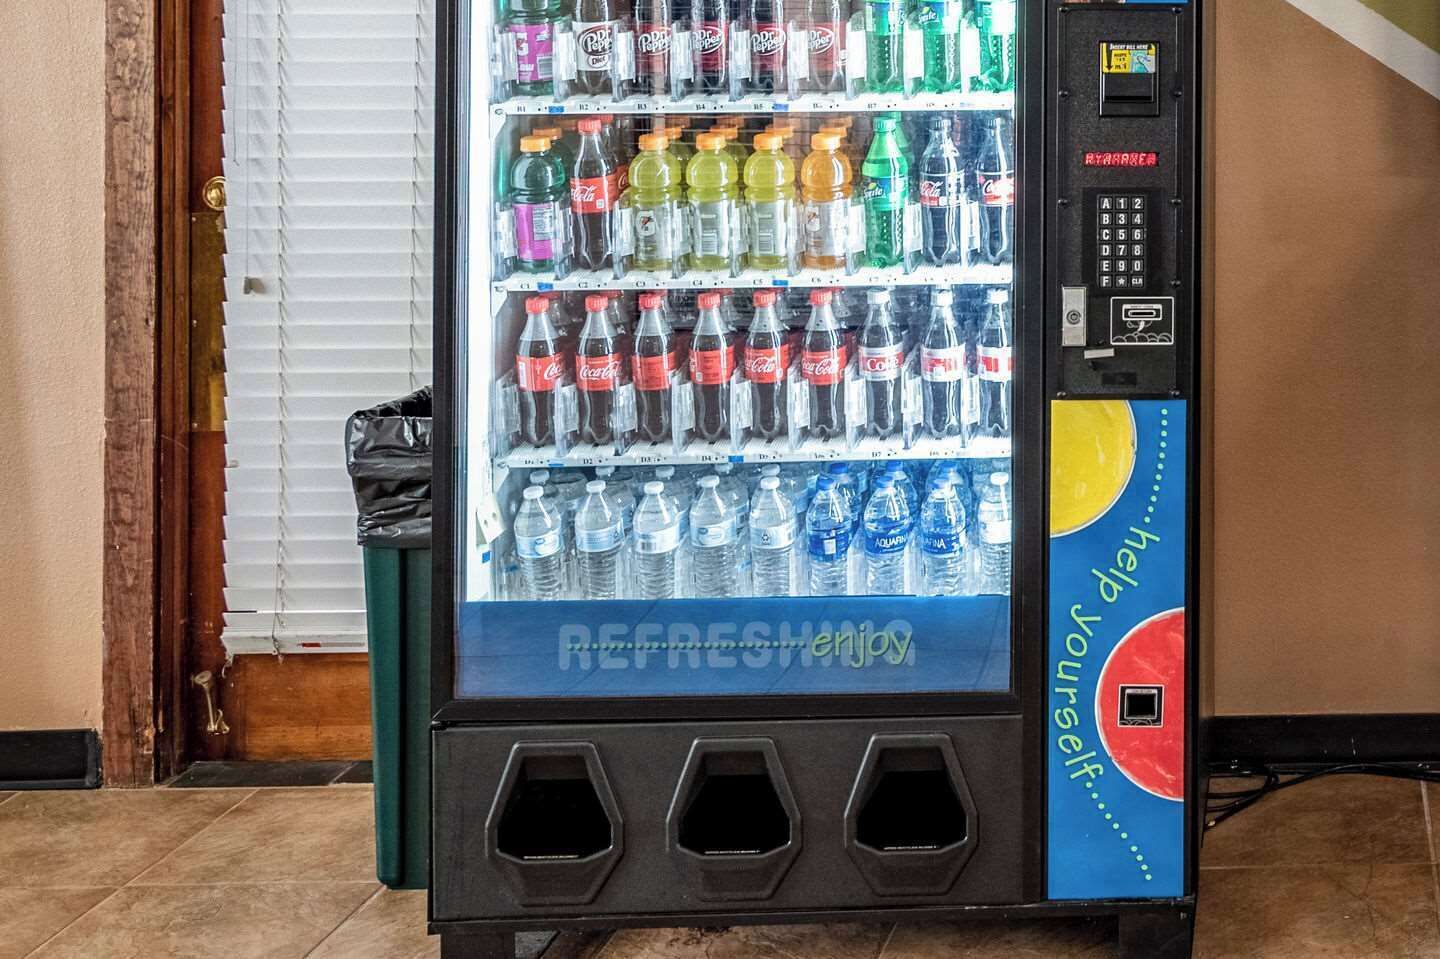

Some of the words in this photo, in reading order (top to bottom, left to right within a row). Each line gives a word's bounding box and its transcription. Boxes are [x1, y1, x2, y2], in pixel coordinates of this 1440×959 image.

[598, 30, 611, 41] Dr
[700, 30, 712, 40] Dr
[760, 30, 775, 41] Dr
[1102, 198, 1110, 209] A
[1119, 198, 1125, 209] 1
[1134, 198, 1141, 209] 2
[1102, 214, 1110, 225] B
[1119, 214, 1125, 225] 3
[1134, 214, 1141, 225] 4
[1102, 229, 1110, 240] C
[1119, 229, 1125, 240] 5
[1134, 229, 1141, 240] 6
[1102, 245, 1110, 256] D
[1119, 245, 1125, 256] 7
[1134, 245, 1141, 256] 8
[1102, 261, 1110, 271] E
[1119, 261, 1125, 271] 9
[1134, 261, 1141, 271] 0
[1102, 276, 1109, 287] F
[875, 533, 909, 549] AQUAFIN
[1092, 524, 1160, 604] help
[811, 623, 912, 669] enjoy
[1054, 603, 1104, 780] yourself
